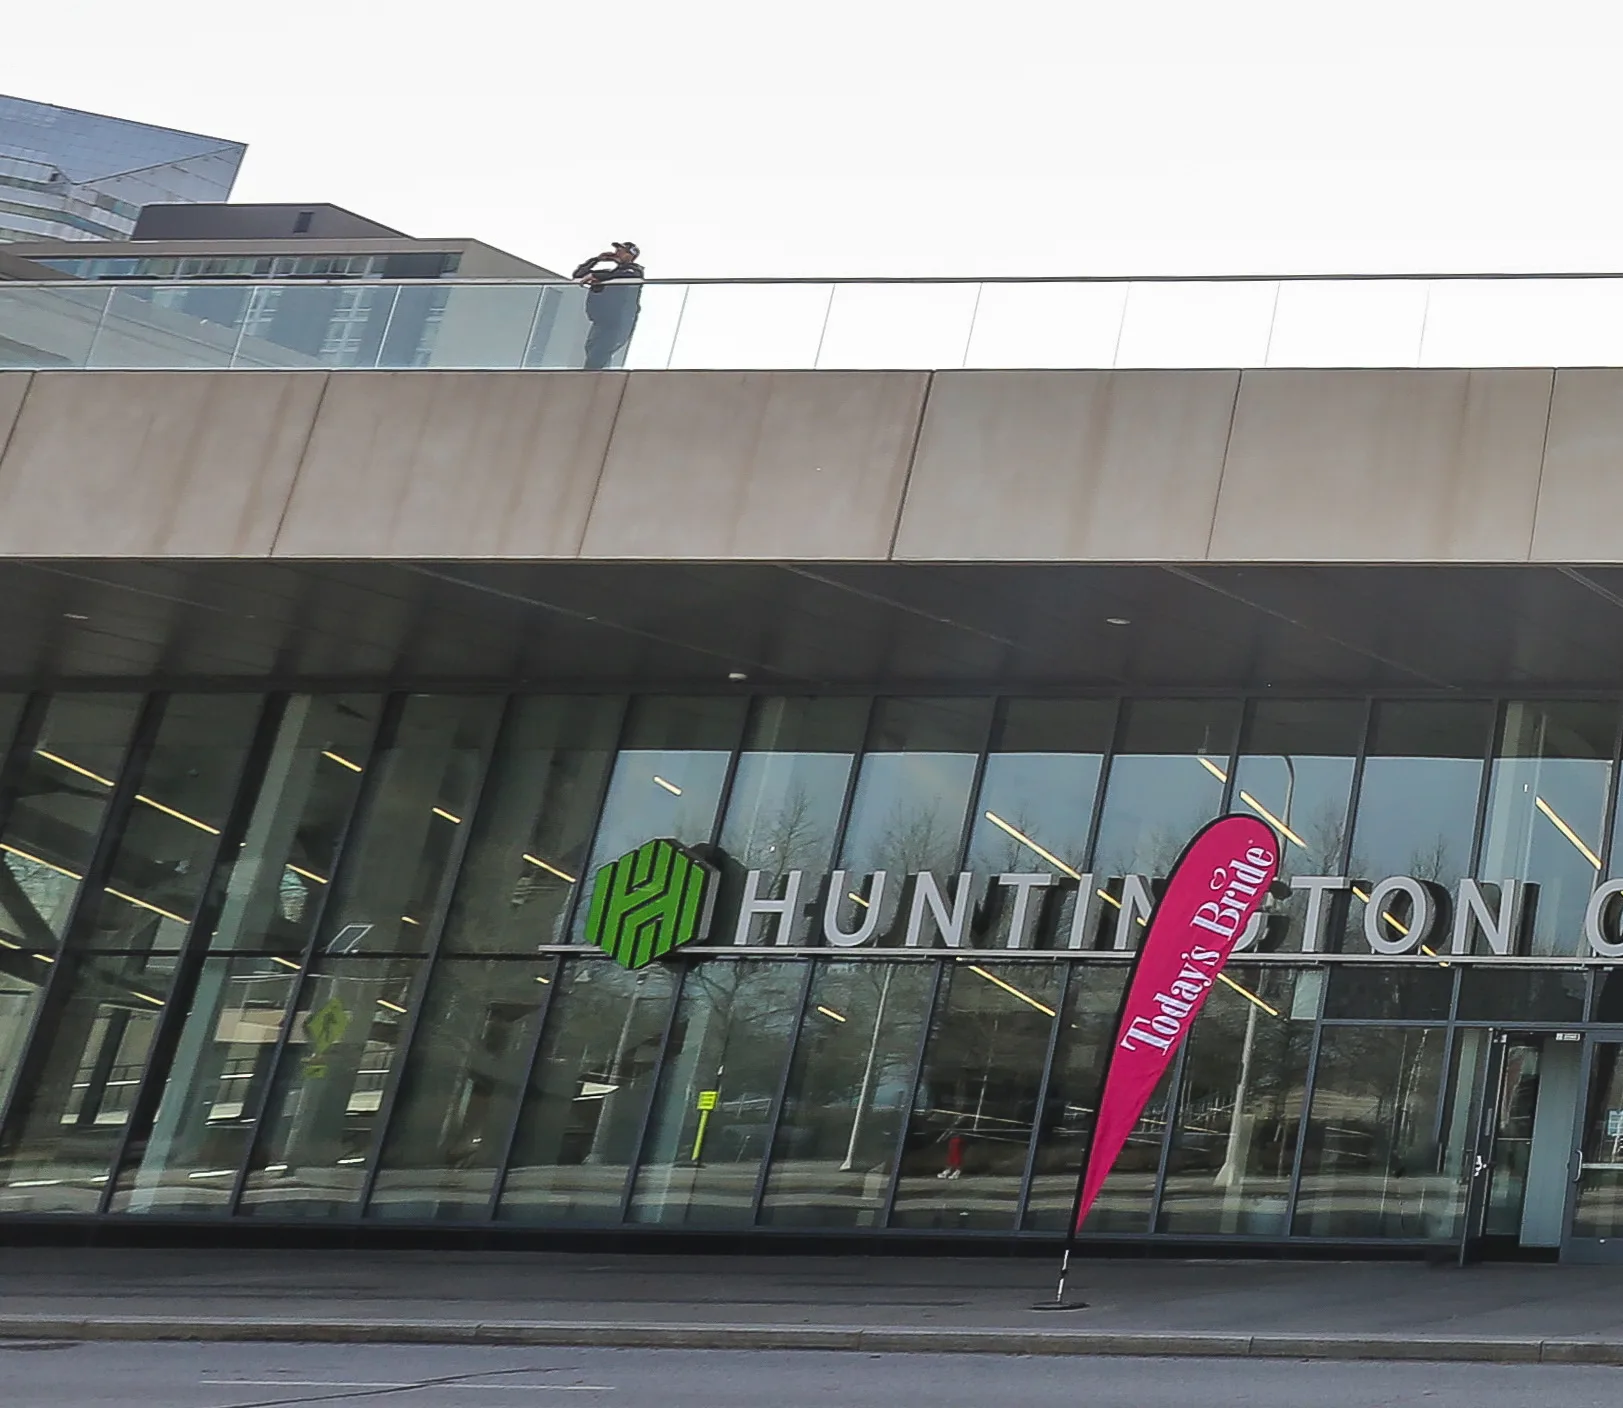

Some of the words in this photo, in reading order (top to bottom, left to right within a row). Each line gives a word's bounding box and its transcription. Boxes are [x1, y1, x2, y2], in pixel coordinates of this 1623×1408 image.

[733, 869, 1519, 956] HUNTINTON
[1120, 945, 1220, 1057] Today's
[1190, 845, 1275, 942] Bride
